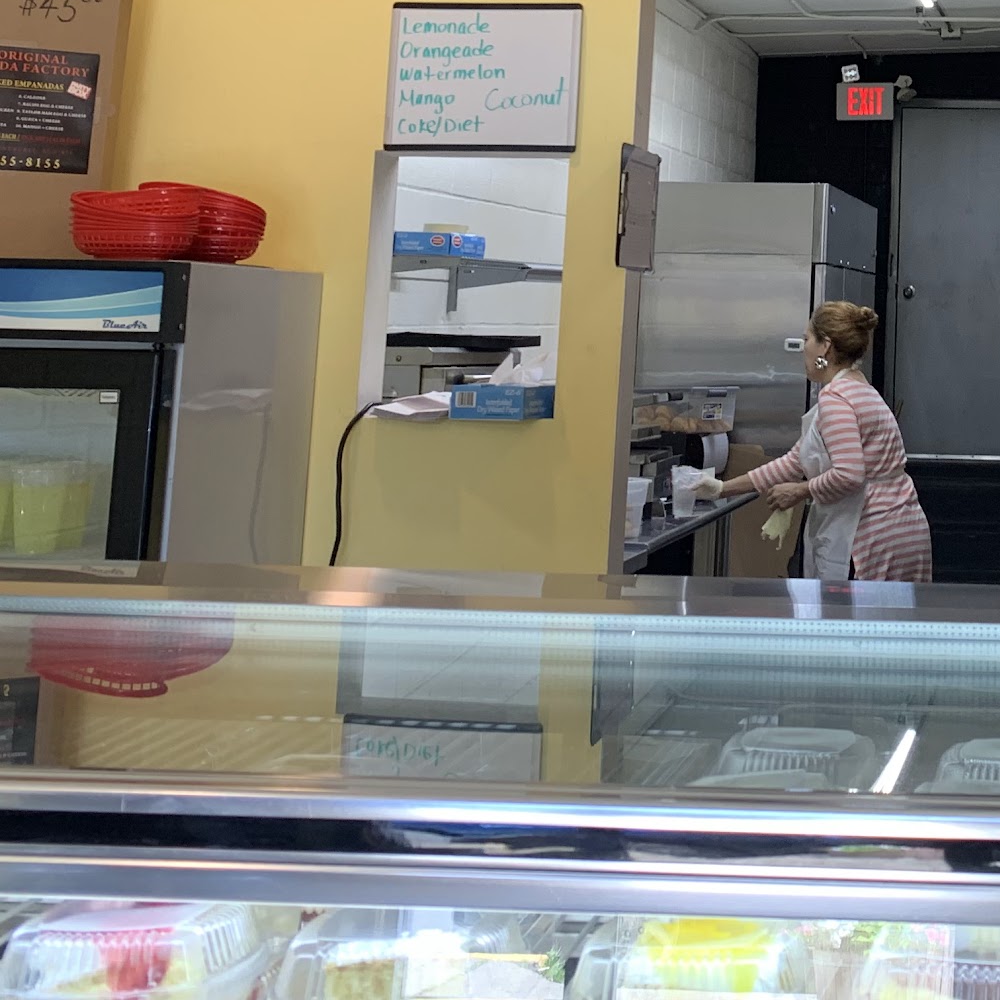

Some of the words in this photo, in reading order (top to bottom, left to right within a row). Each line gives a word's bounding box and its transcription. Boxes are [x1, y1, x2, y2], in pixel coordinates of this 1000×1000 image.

[403, 12, 490, 35] Lemonade
[400, 39, 495, 67] Orangeade
[22, 63, 90, 78] FACTORY
[15, 80, 64, 90] EMPANADAS
[399, 89, 455, 115] Mango
[484, 77, 570, 111] Coconut
[847, 87, 885, 116] EXIT
